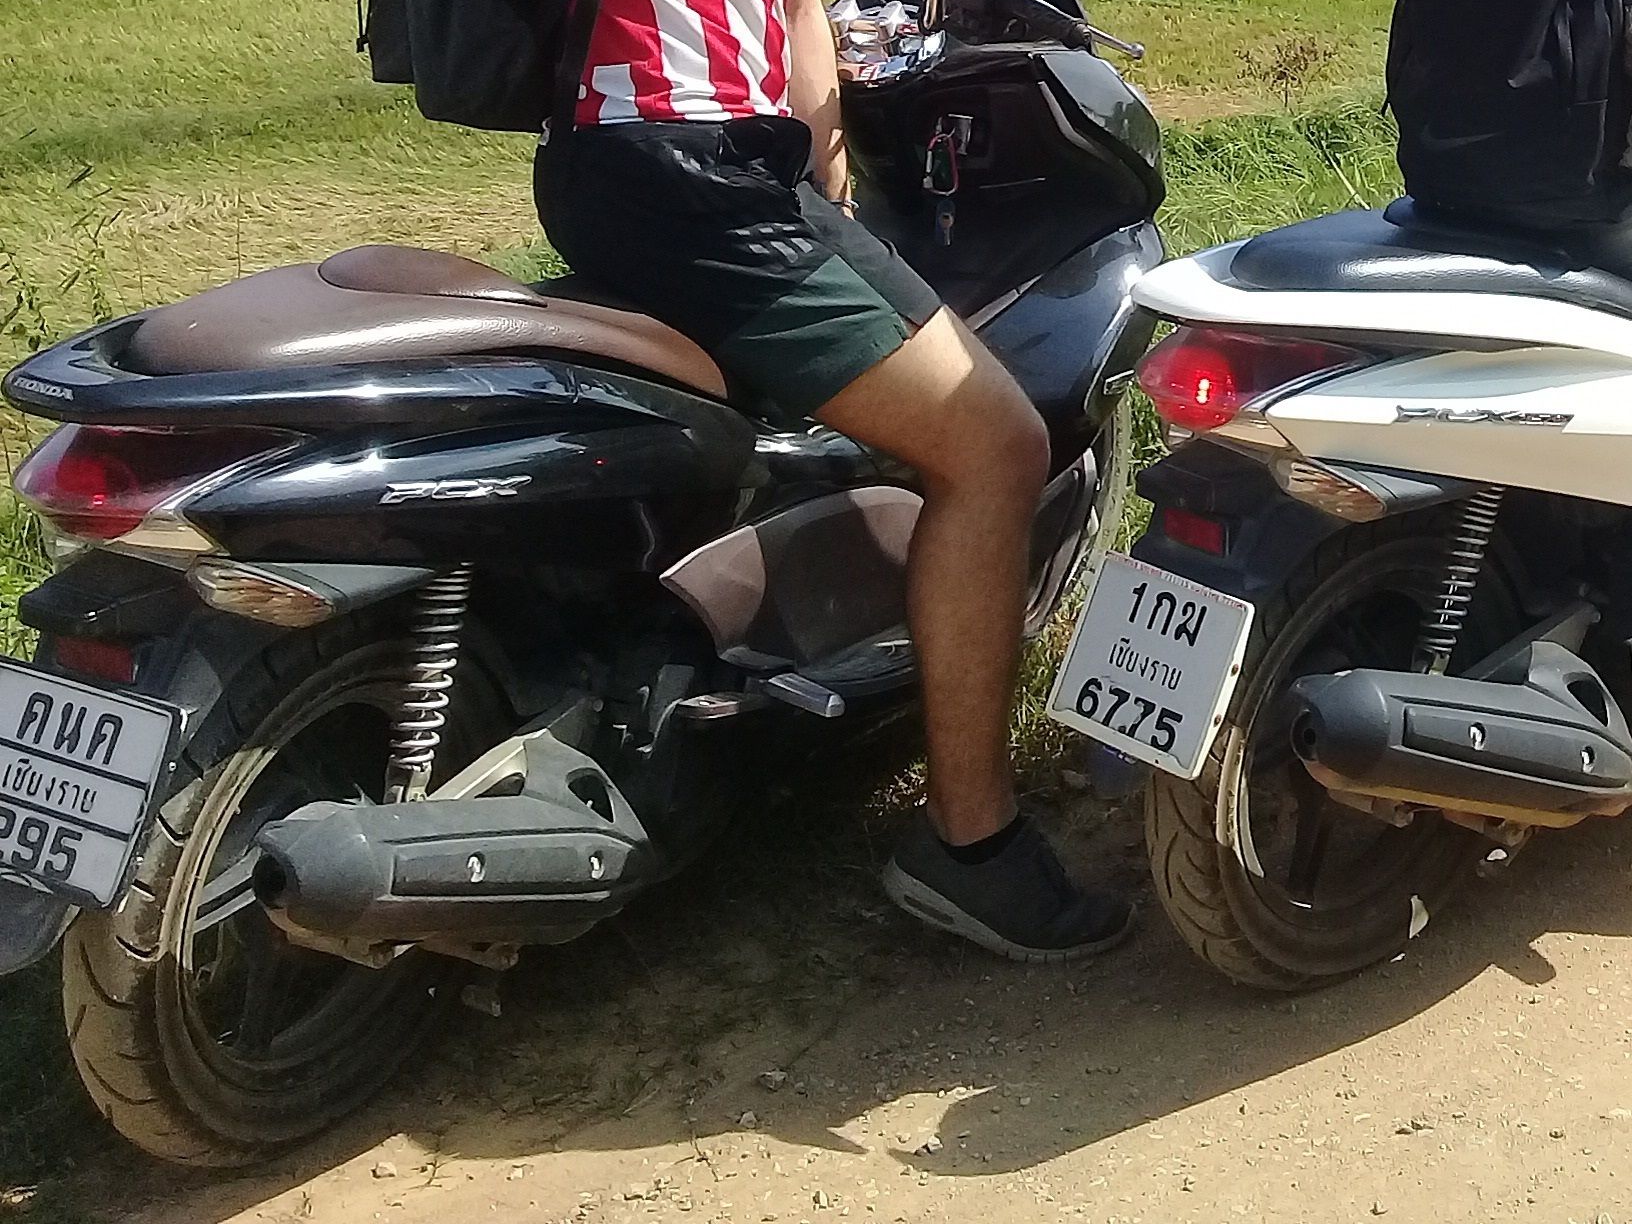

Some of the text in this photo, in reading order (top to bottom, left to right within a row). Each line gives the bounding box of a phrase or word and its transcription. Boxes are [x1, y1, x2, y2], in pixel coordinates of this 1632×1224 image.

[13, 376, 75, 402] HONDA
[378, 475, 534, 505] PCX
[1108, 637, 1183, 691] เชียงราย
[1075, 677, 1184, 753] 6775
[2, 758, 98, 814] เชียงราย
